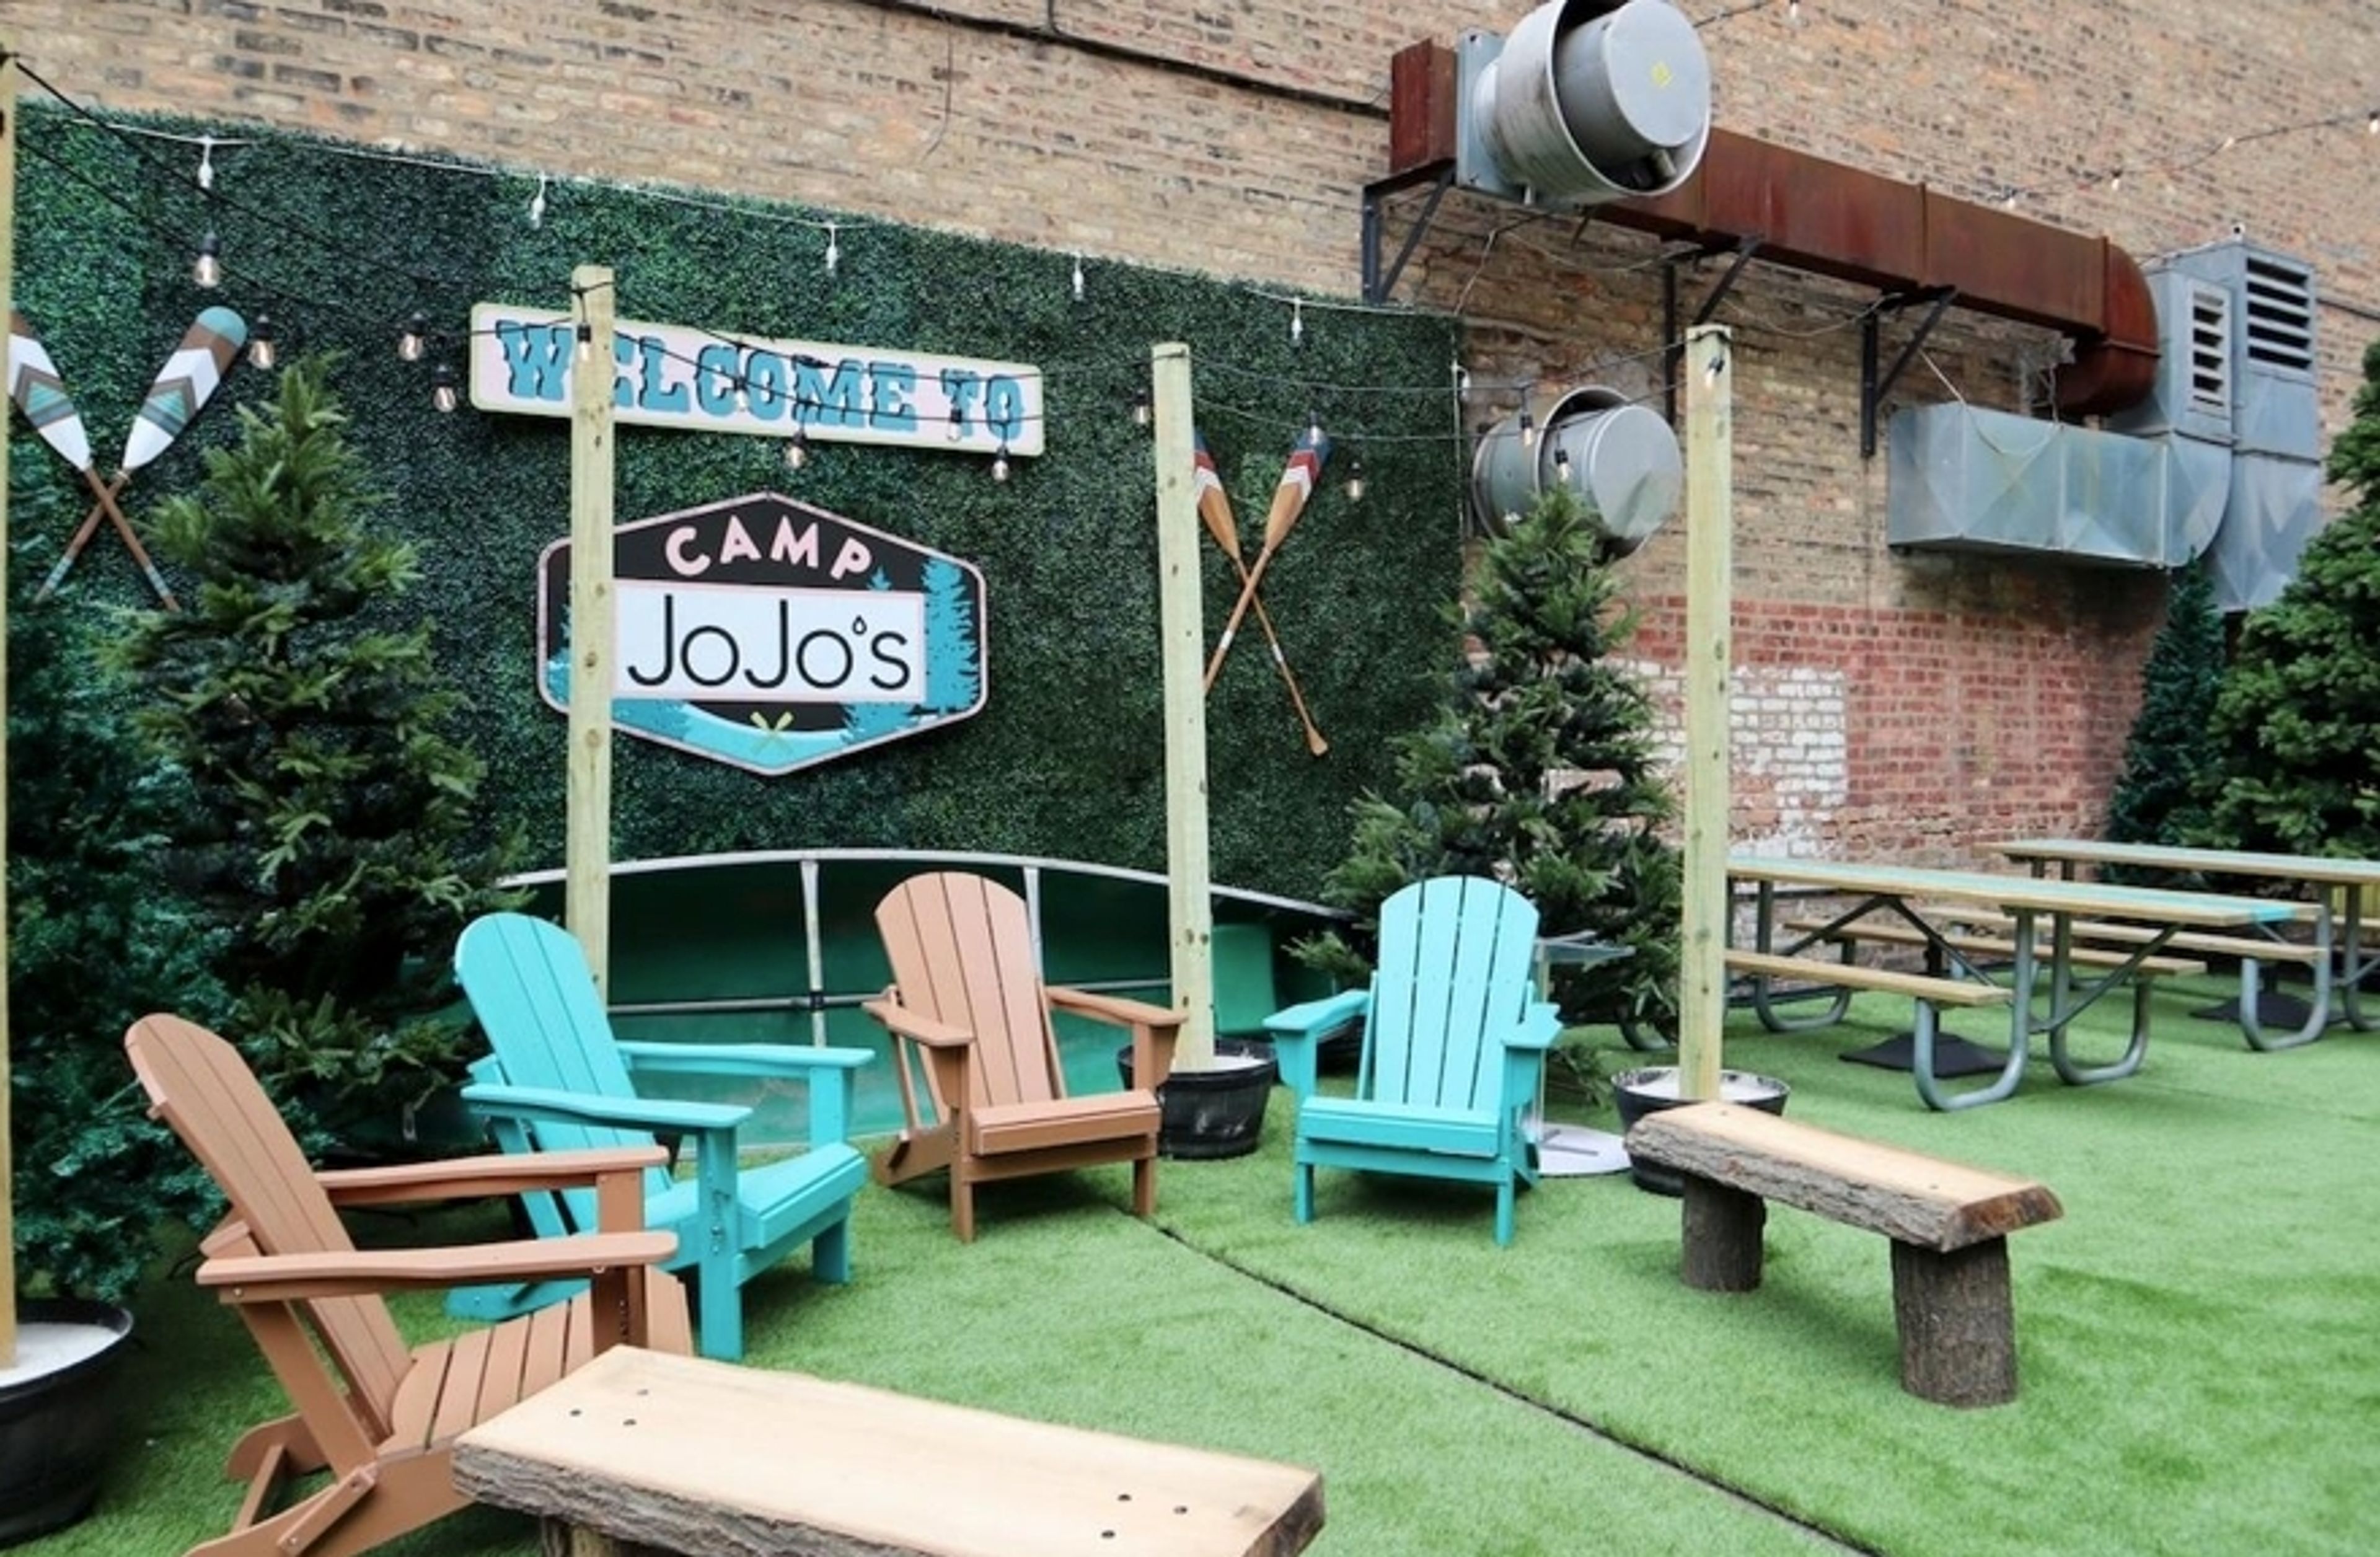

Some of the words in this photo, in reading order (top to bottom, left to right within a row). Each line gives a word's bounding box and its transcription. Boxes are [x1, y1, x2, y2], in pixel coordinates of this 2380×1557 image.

[940, 368, 1023, 439] TO
[665, 514, 871, 580] CAMP
[627, 594, 910, 690] JoJo's
